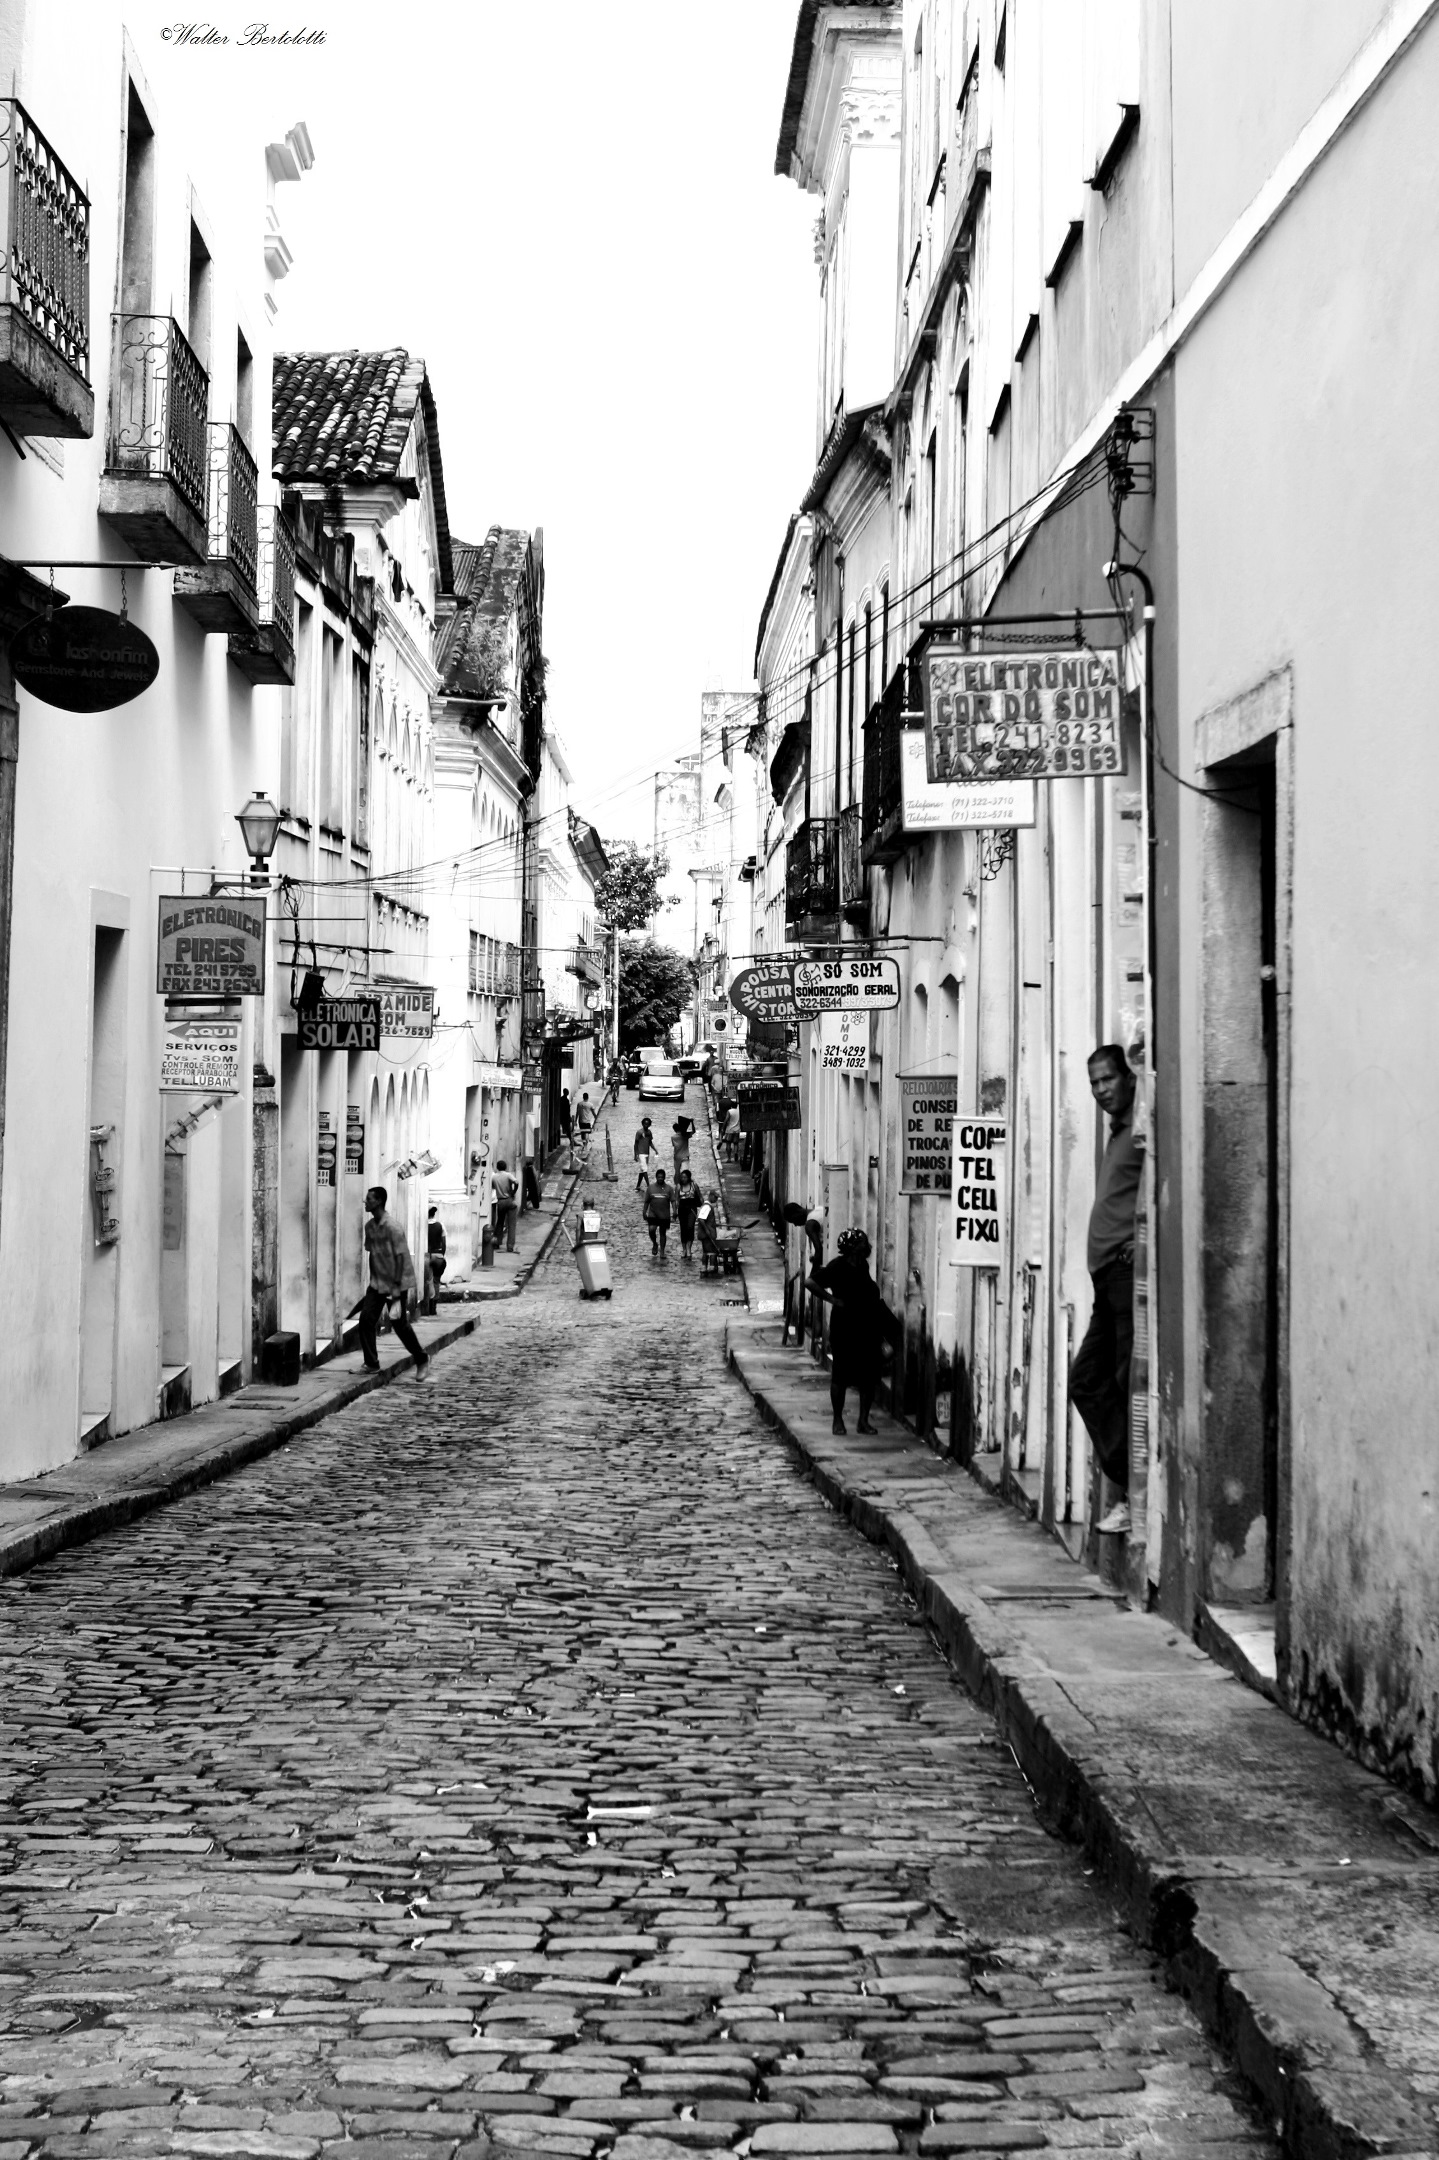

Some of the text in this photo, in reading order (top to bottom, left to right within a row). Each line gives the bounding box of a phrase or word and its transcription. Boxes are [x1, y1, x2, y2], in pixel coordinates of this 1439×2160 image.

[80, 667, 104, 679] And
[109, 669, 150, 682] Jewels
[963, 655, 1118, 691] ELETRÔNICA
[936, 688, 1112, 724] COR DO SOM
[951, 798, 969, 809] (71)
[951, 811, 968, 822] (71)
[162, 905, 262, 940] ELETRÔNICA
[176, 937, 246, 963] PIRES
[165, 964, 192, 976] TEL
[194, 964, 217, 976] 241
[850, 962, 883, 978] SOM
[163, 978, 190, 991] FAX
[193, 978, 220, 991] 243
[796, 984, 897, 998] SONORIZAÇÃO GERAL
[800, 998, 842, 1009] 322-6344
[185, 1028, 235, 1036] AQUI
[302, 1023, 376, 1049] SOLAR
[165, 1043, 238, 1052] SERVIÇOS
[824, 1045, 866, 1057] 321-4299
[202, 1055, 233, 1063] SOM
[823, 1057, 866, 1068] 3489-1032
[161, 1068, 196, 1076] RECEPTOR
[162, 1061, 239, 1071] CONTROLE REMOTO
[908, 1119, 923, 1133] DE
[907, 1156, 945, 1170] PINOS
[916, 1174, 930, 1189] DE
[956, 1217, 999, 1243] FIXO
